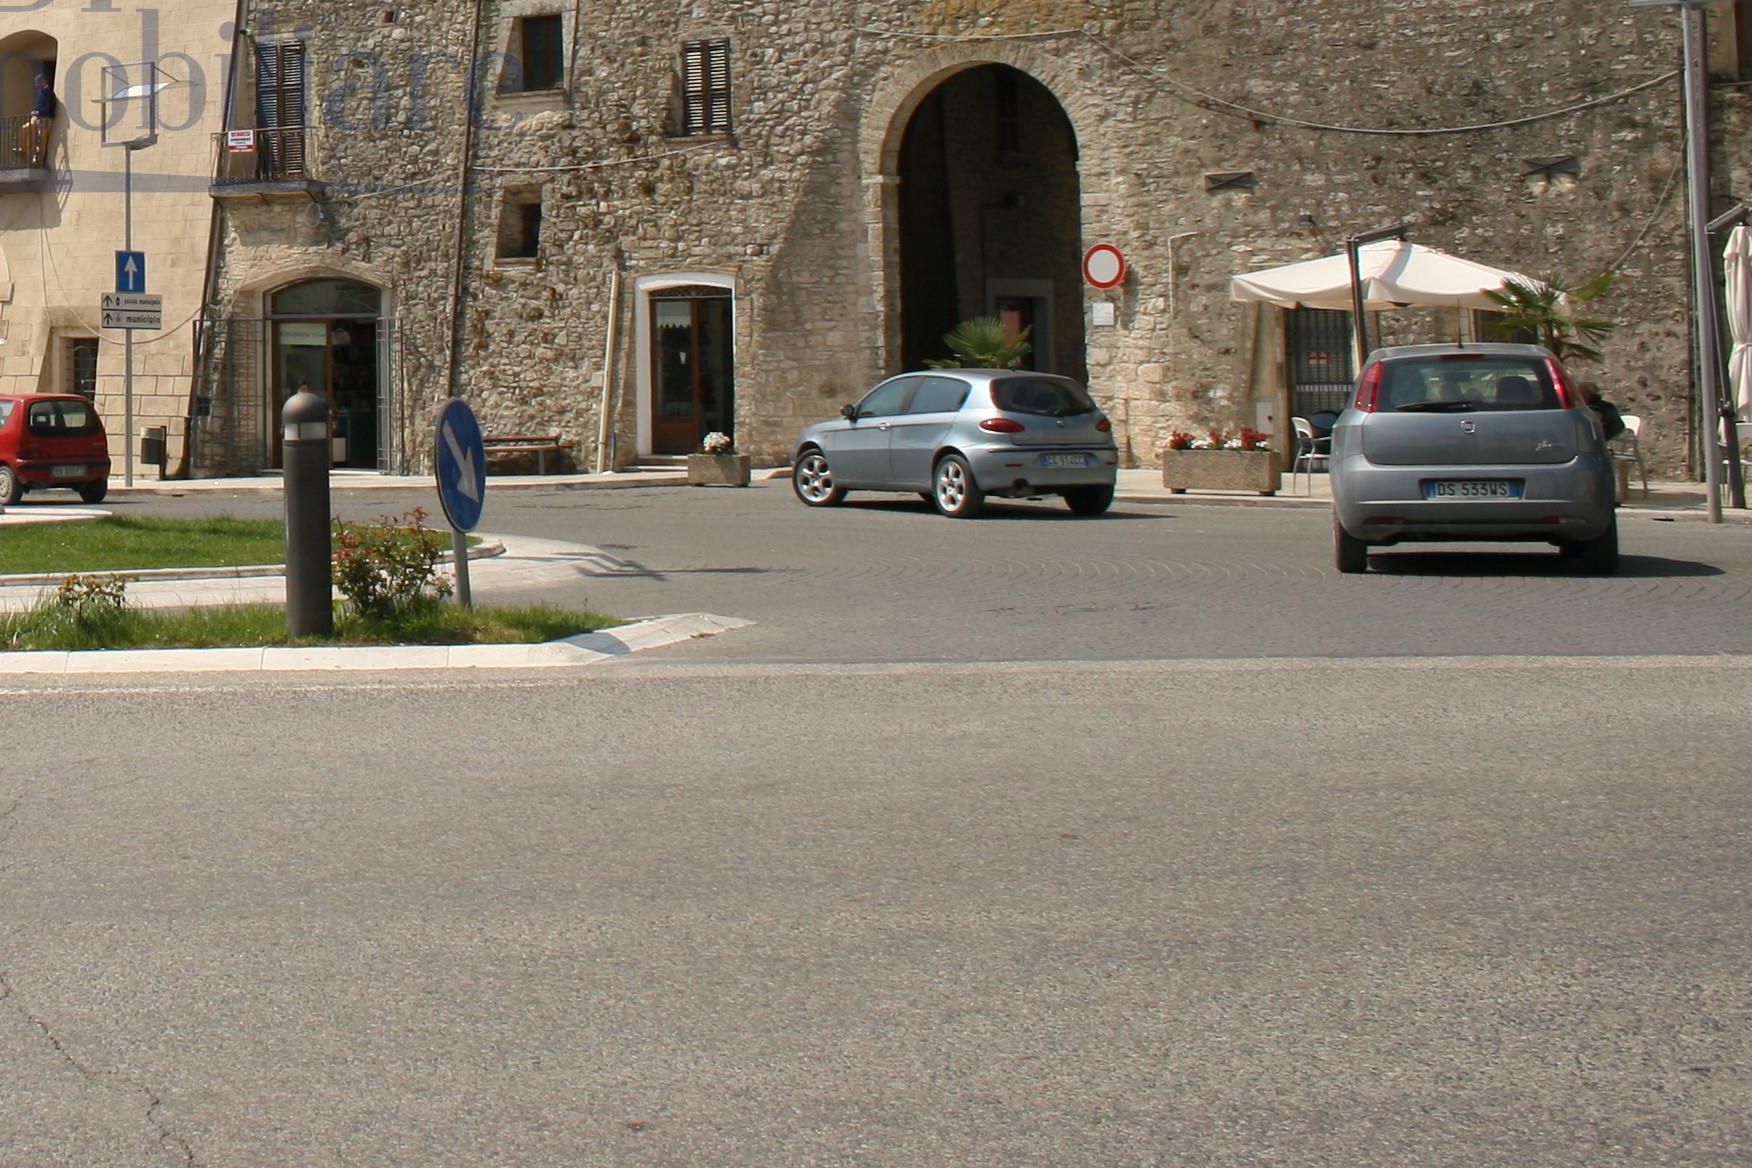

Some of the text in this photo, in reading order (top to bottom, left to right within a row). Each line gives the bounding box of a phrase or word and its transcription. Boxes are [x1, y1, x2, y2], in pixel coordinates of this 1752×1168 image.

[126, 314, 160, 324] municipio
[1437, 483, 1508, 496] DS 533WS
